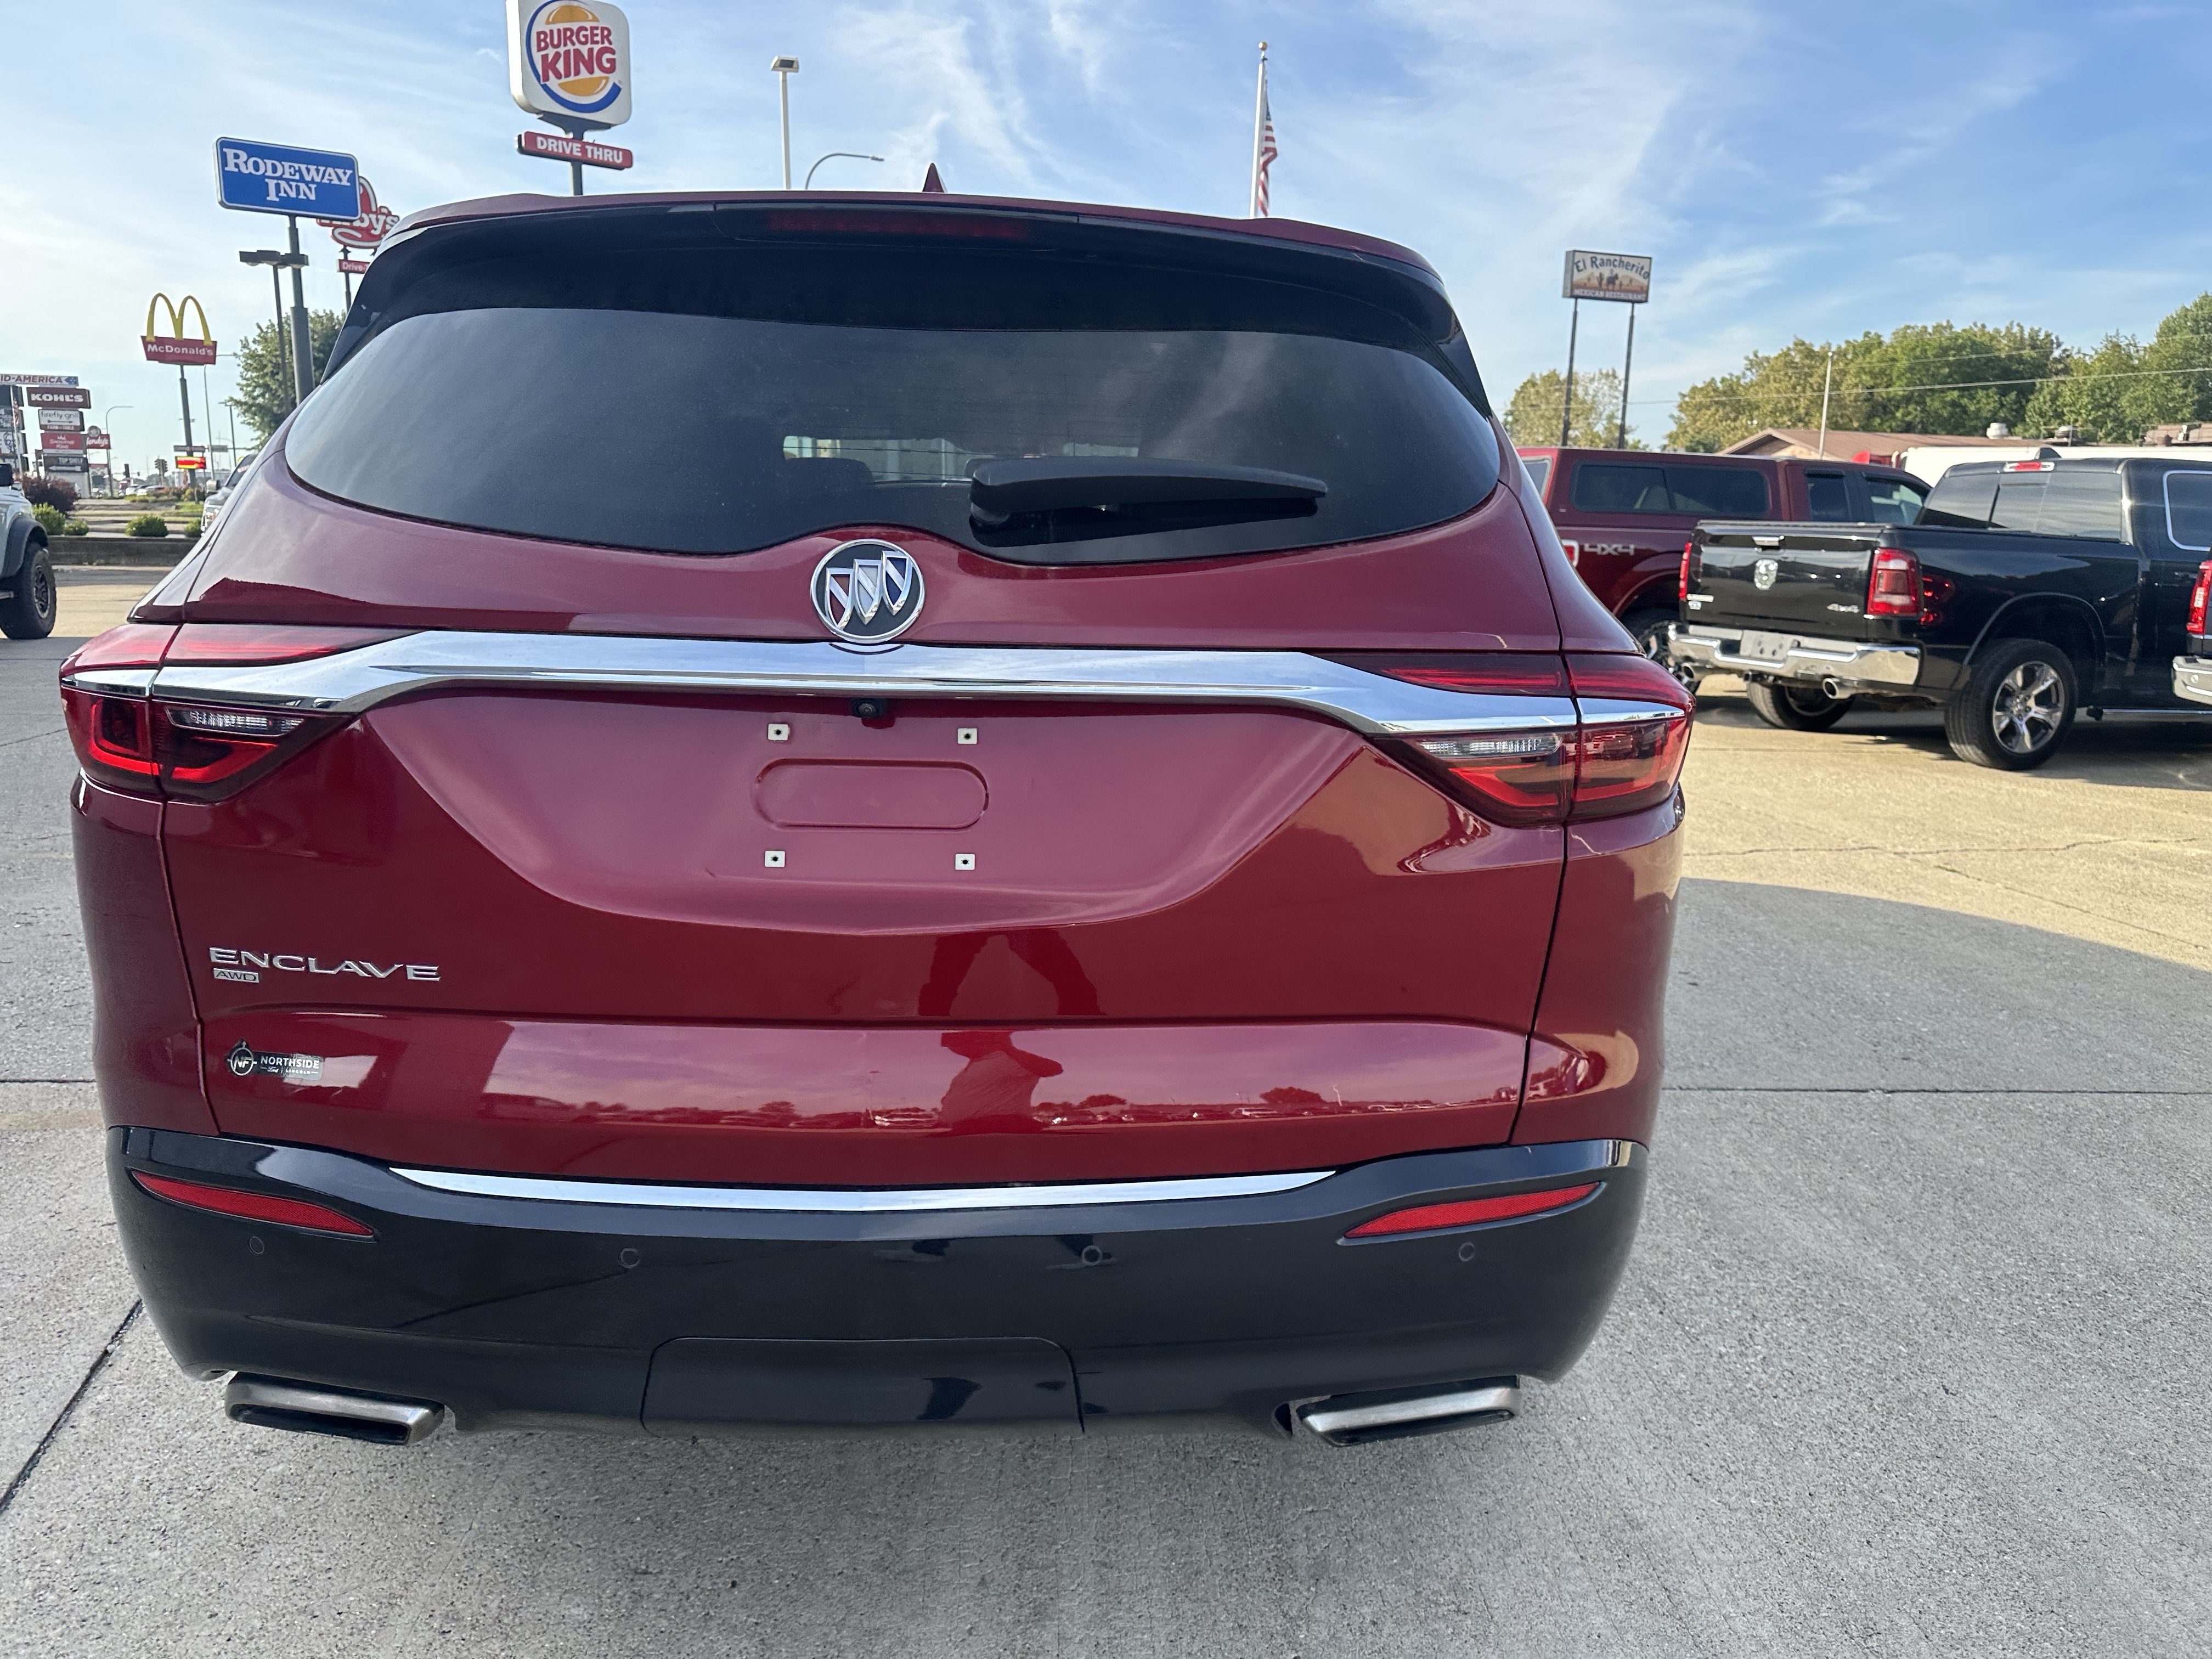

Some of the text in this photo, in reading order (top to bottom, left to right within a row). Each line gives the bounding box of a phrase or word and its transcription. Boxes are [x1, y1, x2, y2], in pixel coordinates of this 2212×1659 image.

[536, 26, 612, 52] BURGER
[540, 46, 616, 82] KING
[536, 137, 623, 163] DRIVE THRU
[223, 148, 353, 186] RODEWAY
[264, 178, 316, 201] INN
[1574, 256, 1650, 279] El Rancherito
[147, 344, 213, 356] McDonald's
[1, 374, 63, 383] ID-AMERICA
[31, 393, 83, 402] KOHL'S
[209, 947, 441, 981] ENCLAVE
[216, 970, 257, 981] AWD
[261, 1056, 320, 1069] NORTHSIDE
